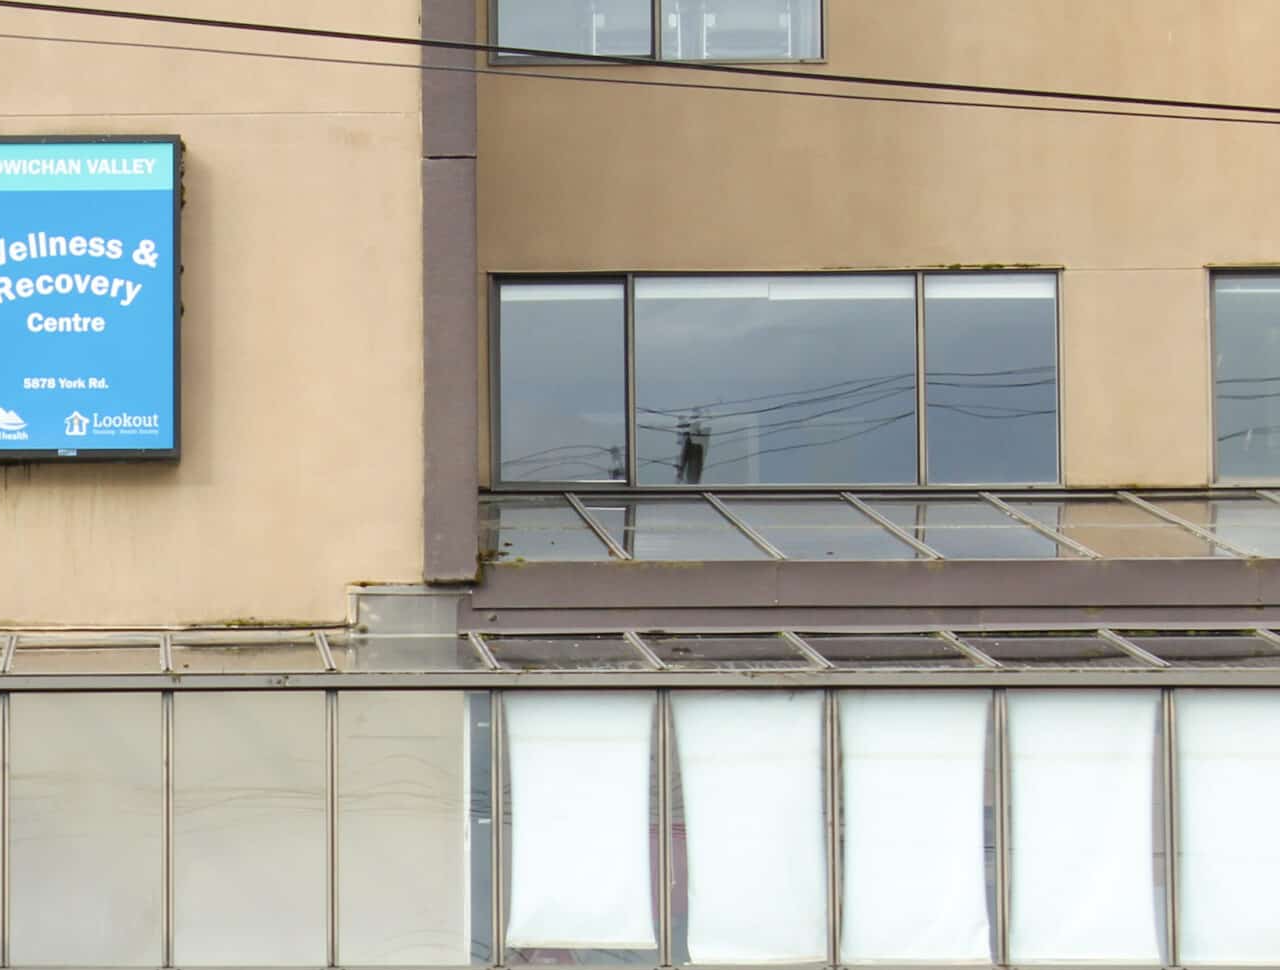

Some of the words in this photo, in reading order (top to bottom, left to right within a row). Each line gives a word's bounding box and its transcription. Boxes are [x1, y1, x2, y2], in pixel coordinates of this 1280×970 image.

[86, 158, 156, 175] VALLEY
[132, 239, 159, 268] &
[26, 312, 105, 332] Centre
[23, 377, 56, 389] 5878
[58, 377, 86, 389] York
[88, 377, 109, 389] Rd.
[92, 412, 159, 428] Lookout
